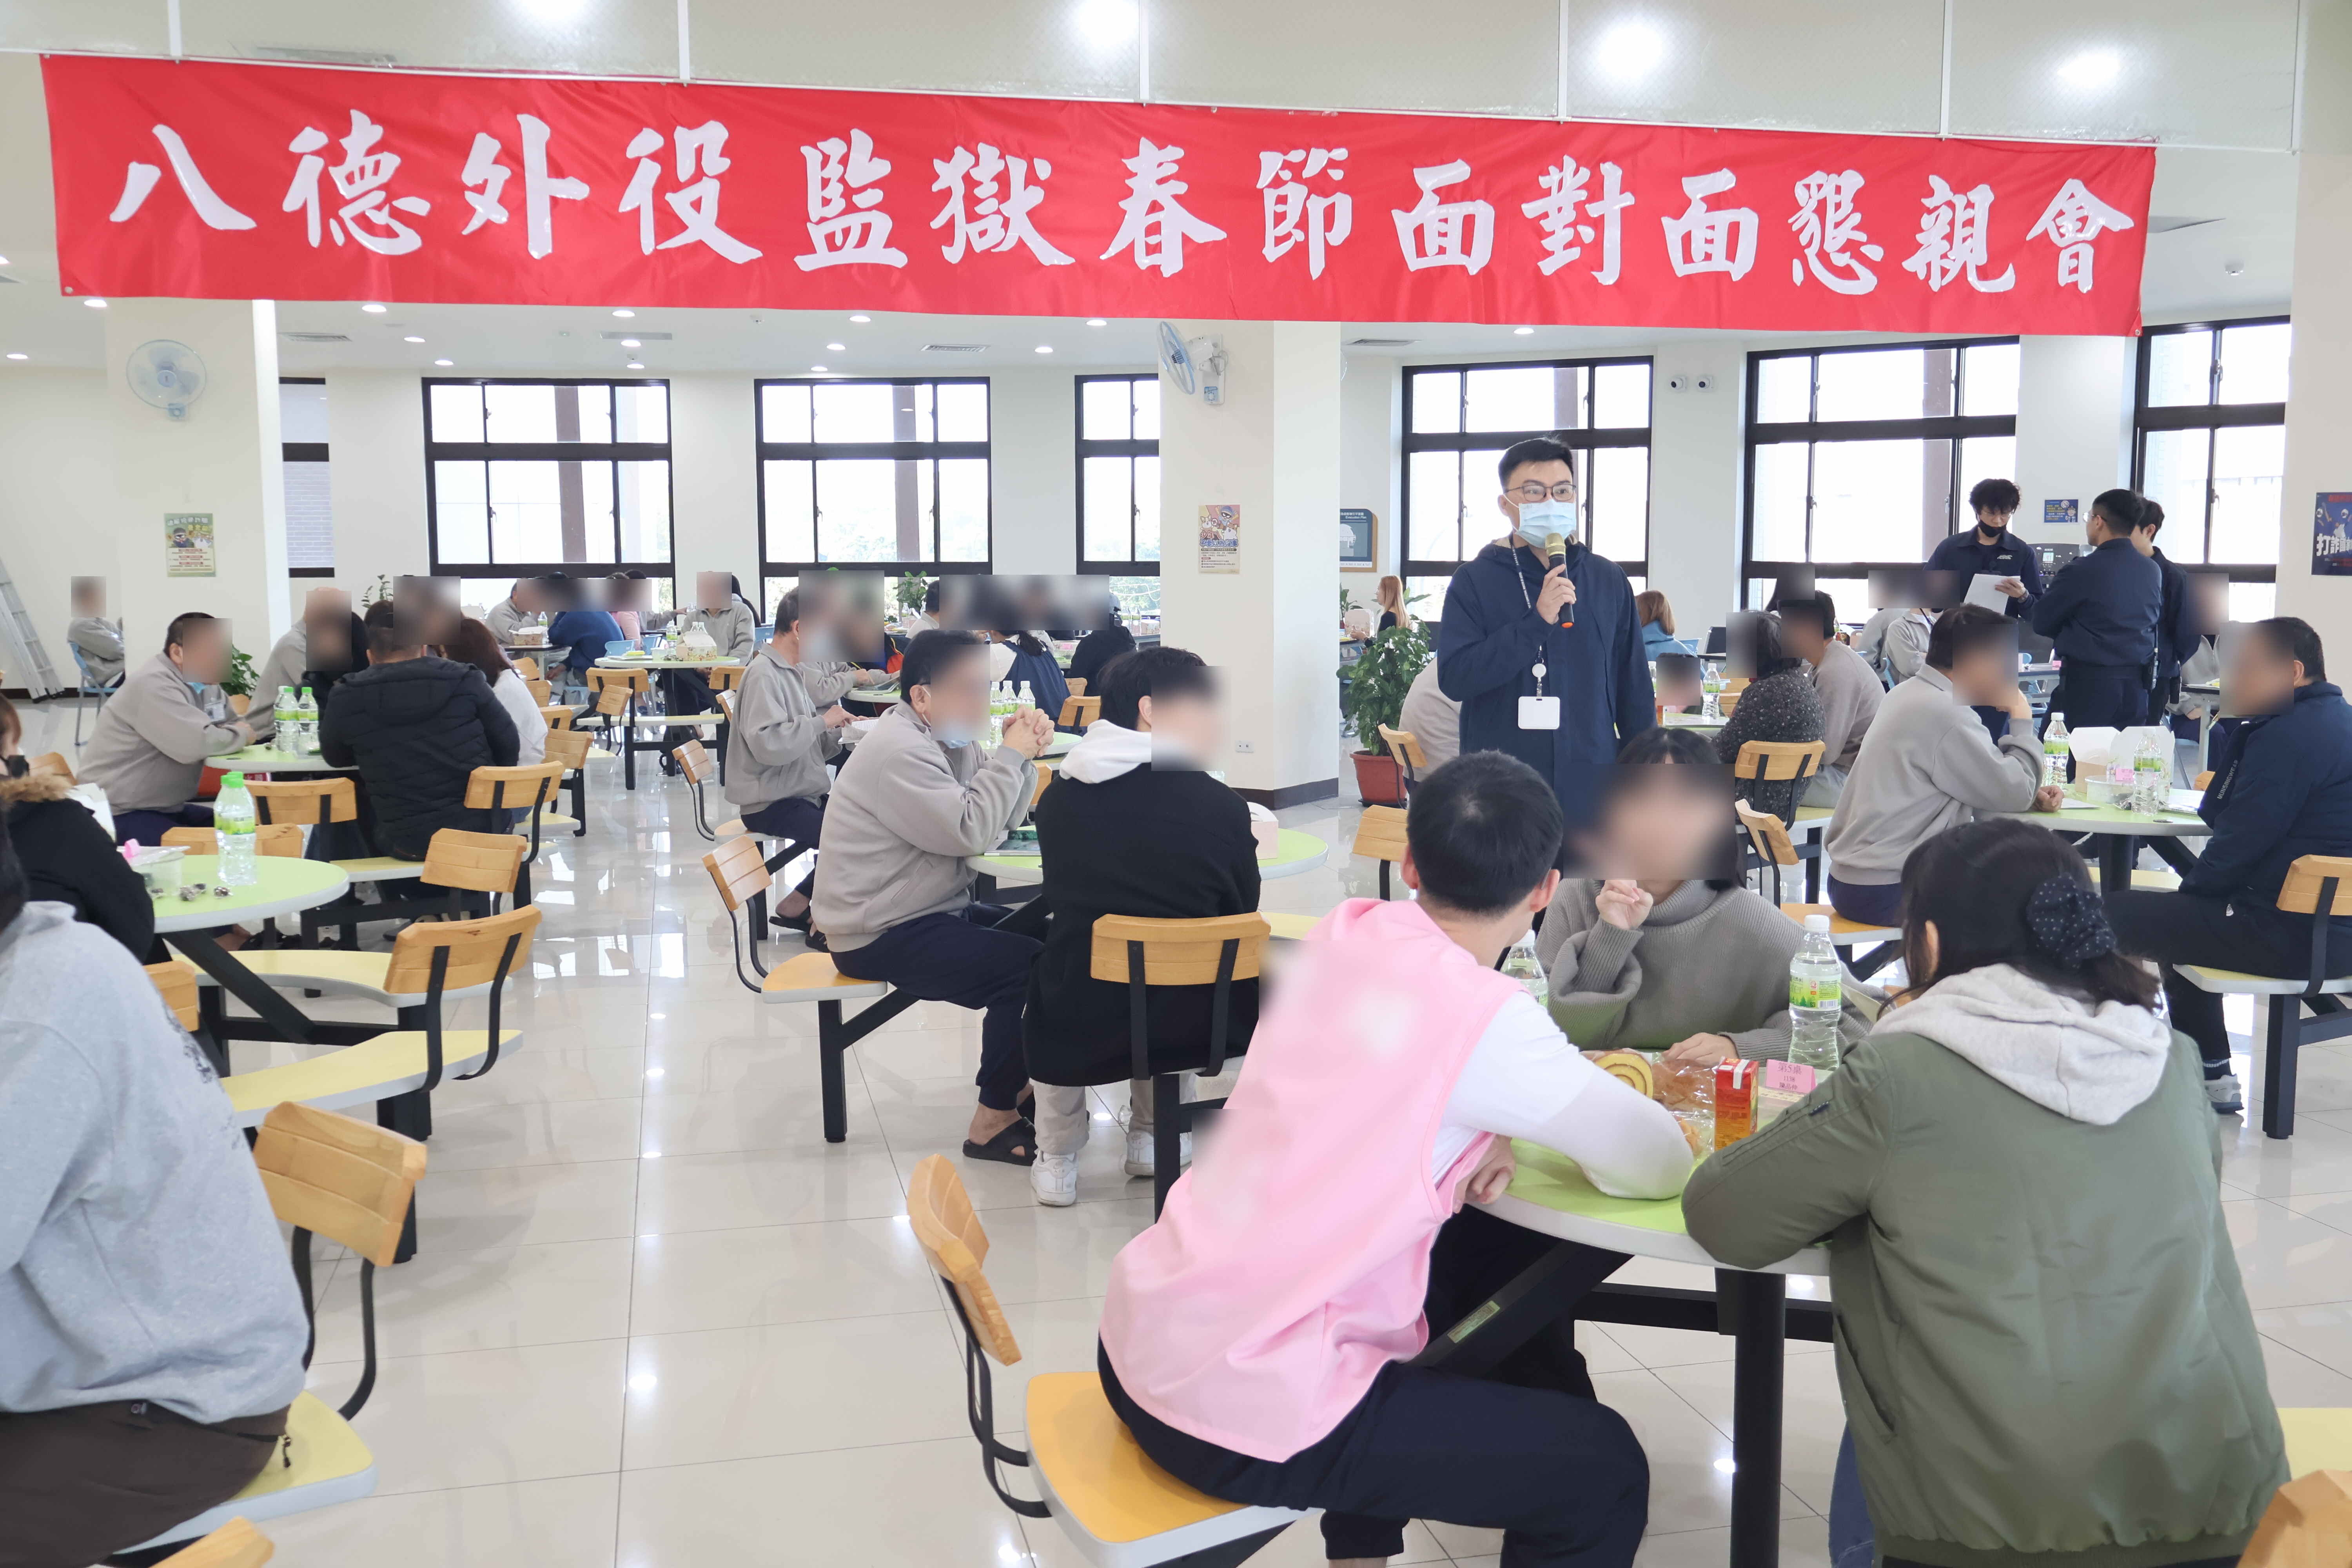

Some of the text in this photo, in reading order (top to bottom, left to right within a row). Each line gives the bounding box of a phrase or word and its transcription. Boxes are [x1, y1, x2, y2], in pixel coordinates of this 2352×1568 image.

[109, 109, 2135, 296] 八德外役監獄春節面對面懇親會
[2217, 759, 2238, 800] MUNSINGWEAR
[1778, 1062, 1802, 1075] 第5桌
